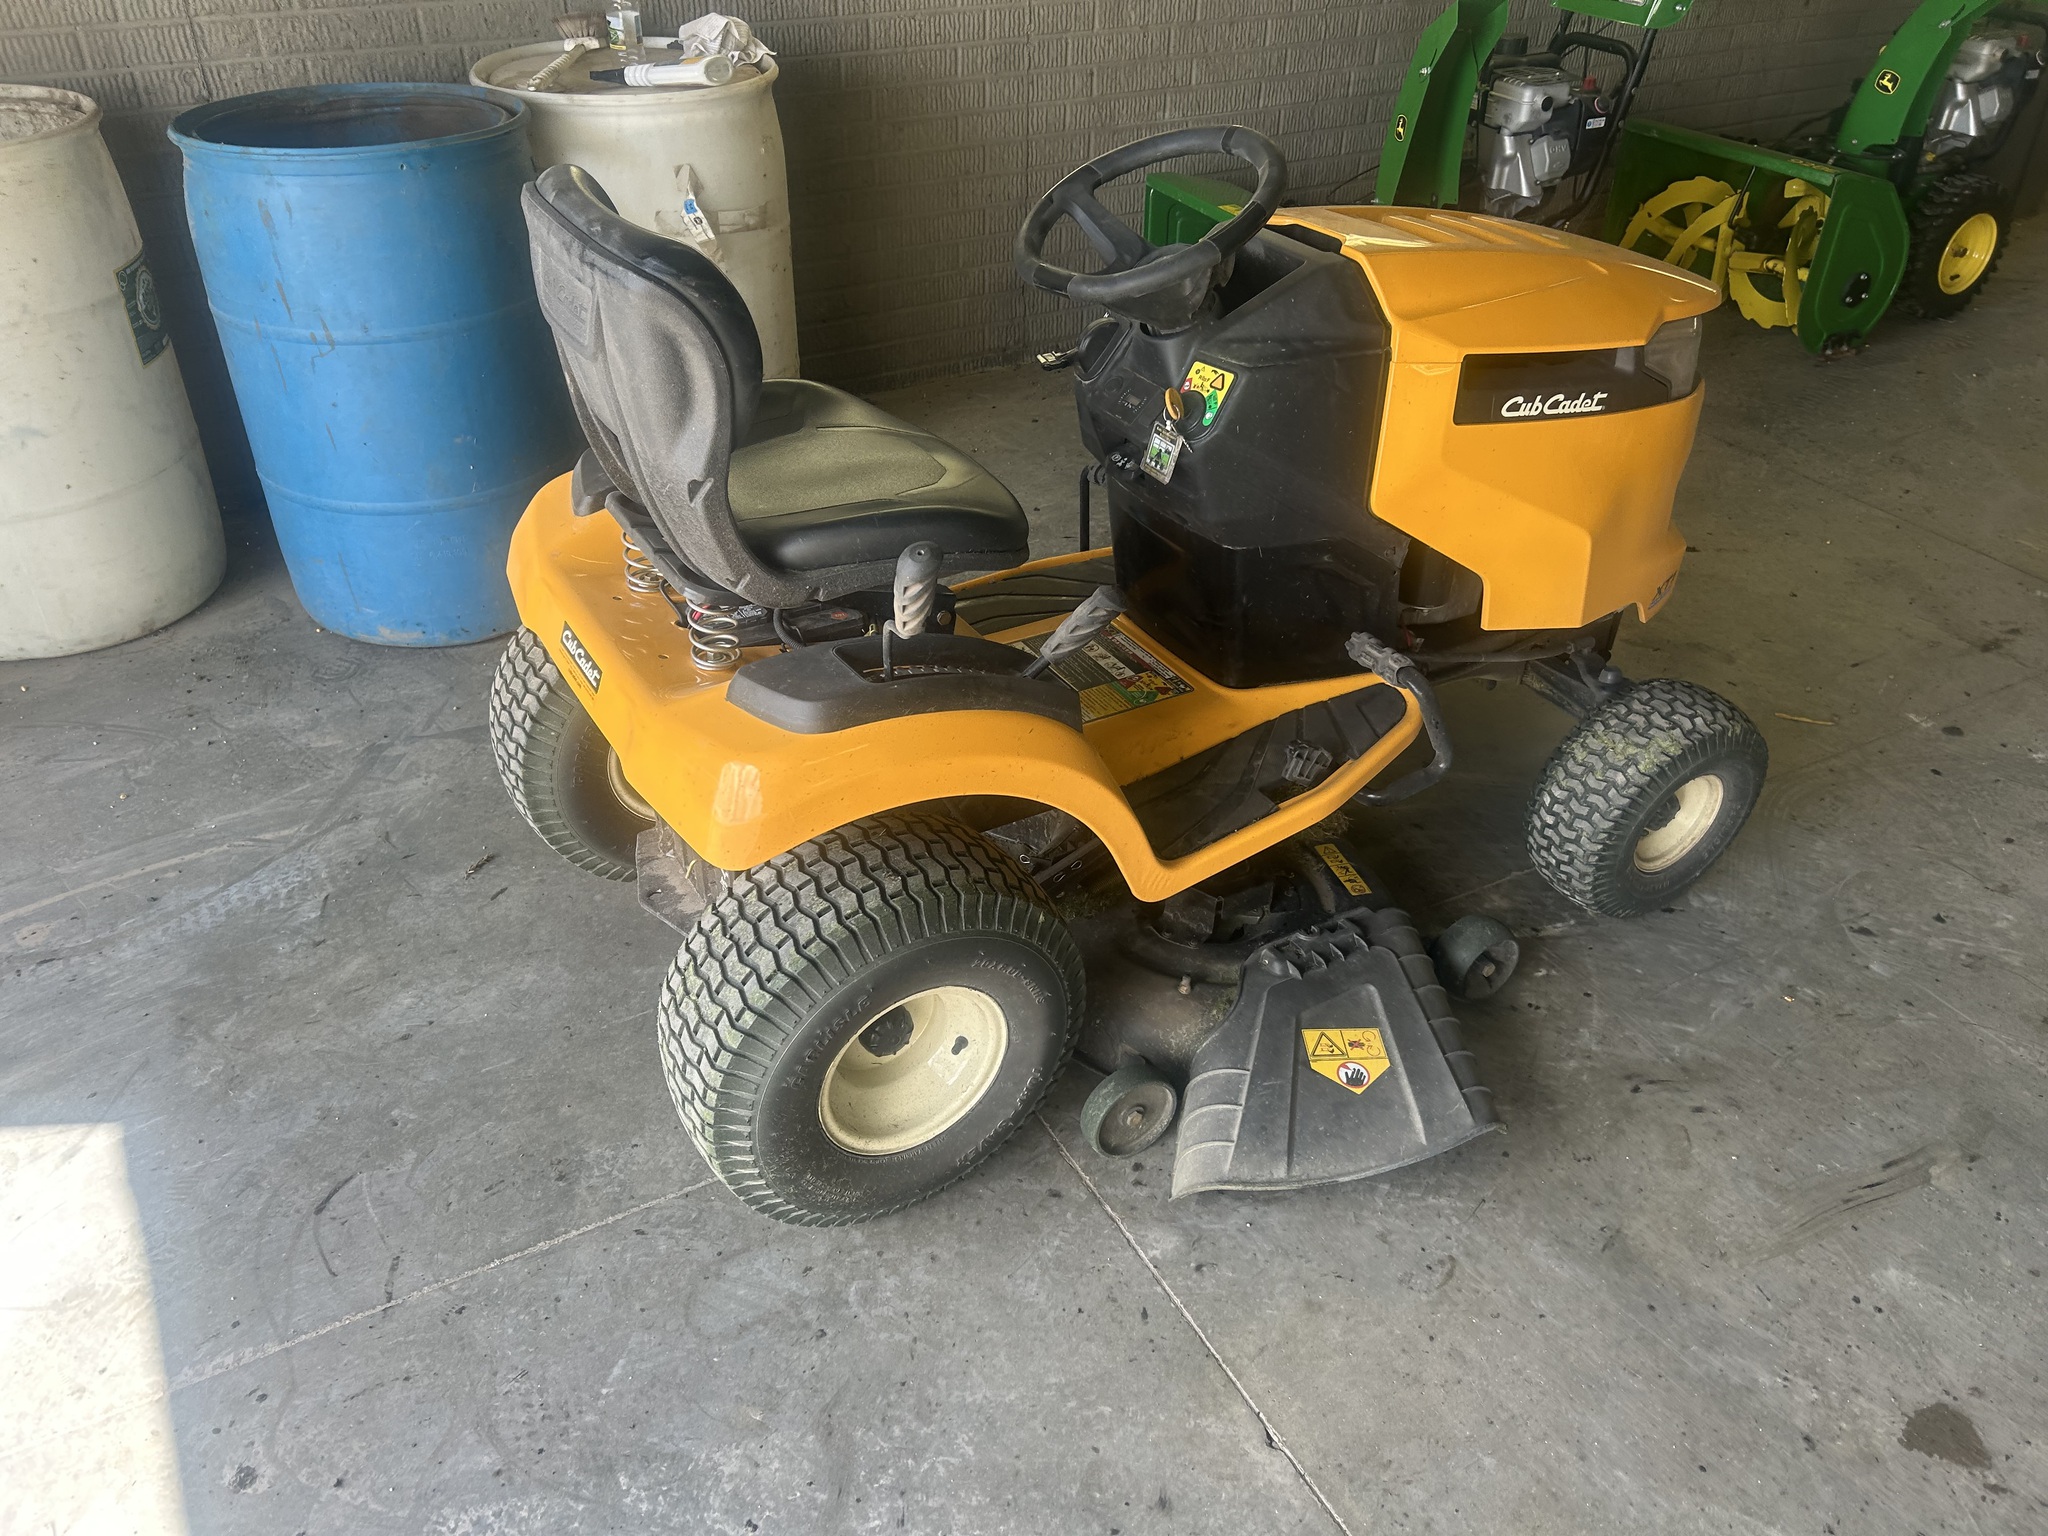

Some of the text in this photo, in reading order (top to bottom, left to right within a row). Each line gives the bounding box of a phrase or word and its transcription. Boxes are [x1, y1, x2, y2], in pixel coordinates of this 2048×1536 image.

[1501, 391, 1608, 417] Cub Cadet
[562, 630, 578, 655] Cub
[574, 648, 601, 687] Cadet
[789, 994, 873, 1091] CARLISLE
